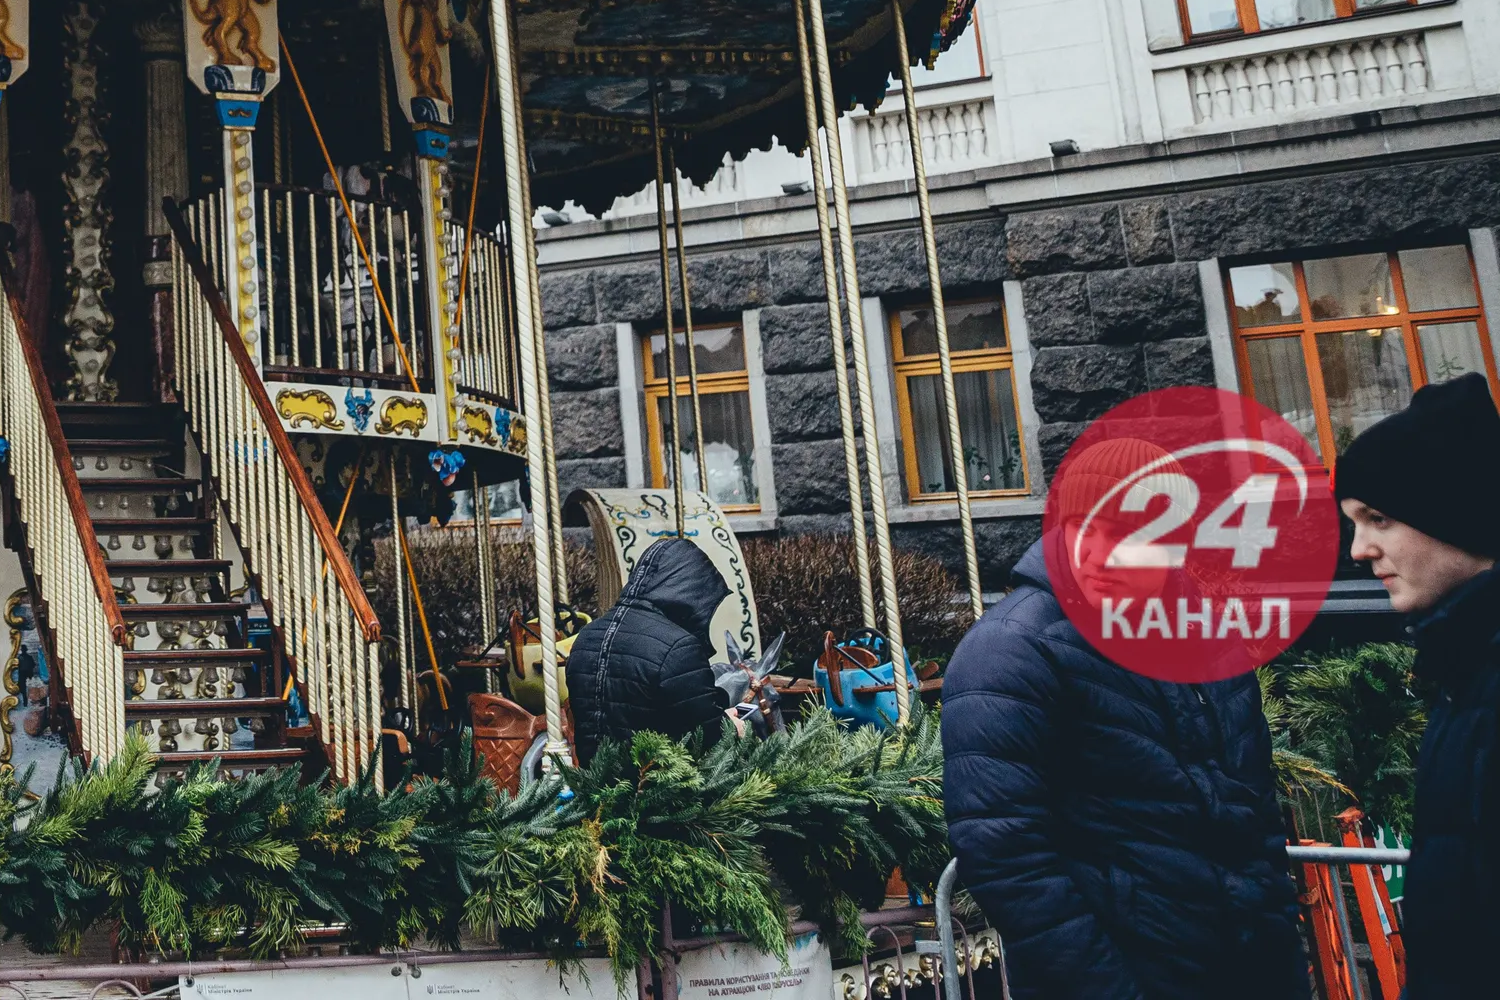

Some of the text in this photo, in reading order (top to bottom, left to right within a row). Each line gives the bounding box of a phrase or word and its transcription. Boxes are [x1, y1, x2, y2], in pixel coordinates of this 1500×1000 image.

[689, 978, 726, 988] ПРАВИЛА
[726, 972, 770, 986] КОРИСТУВАННЯ
[708, 988, 720, 997] НА
